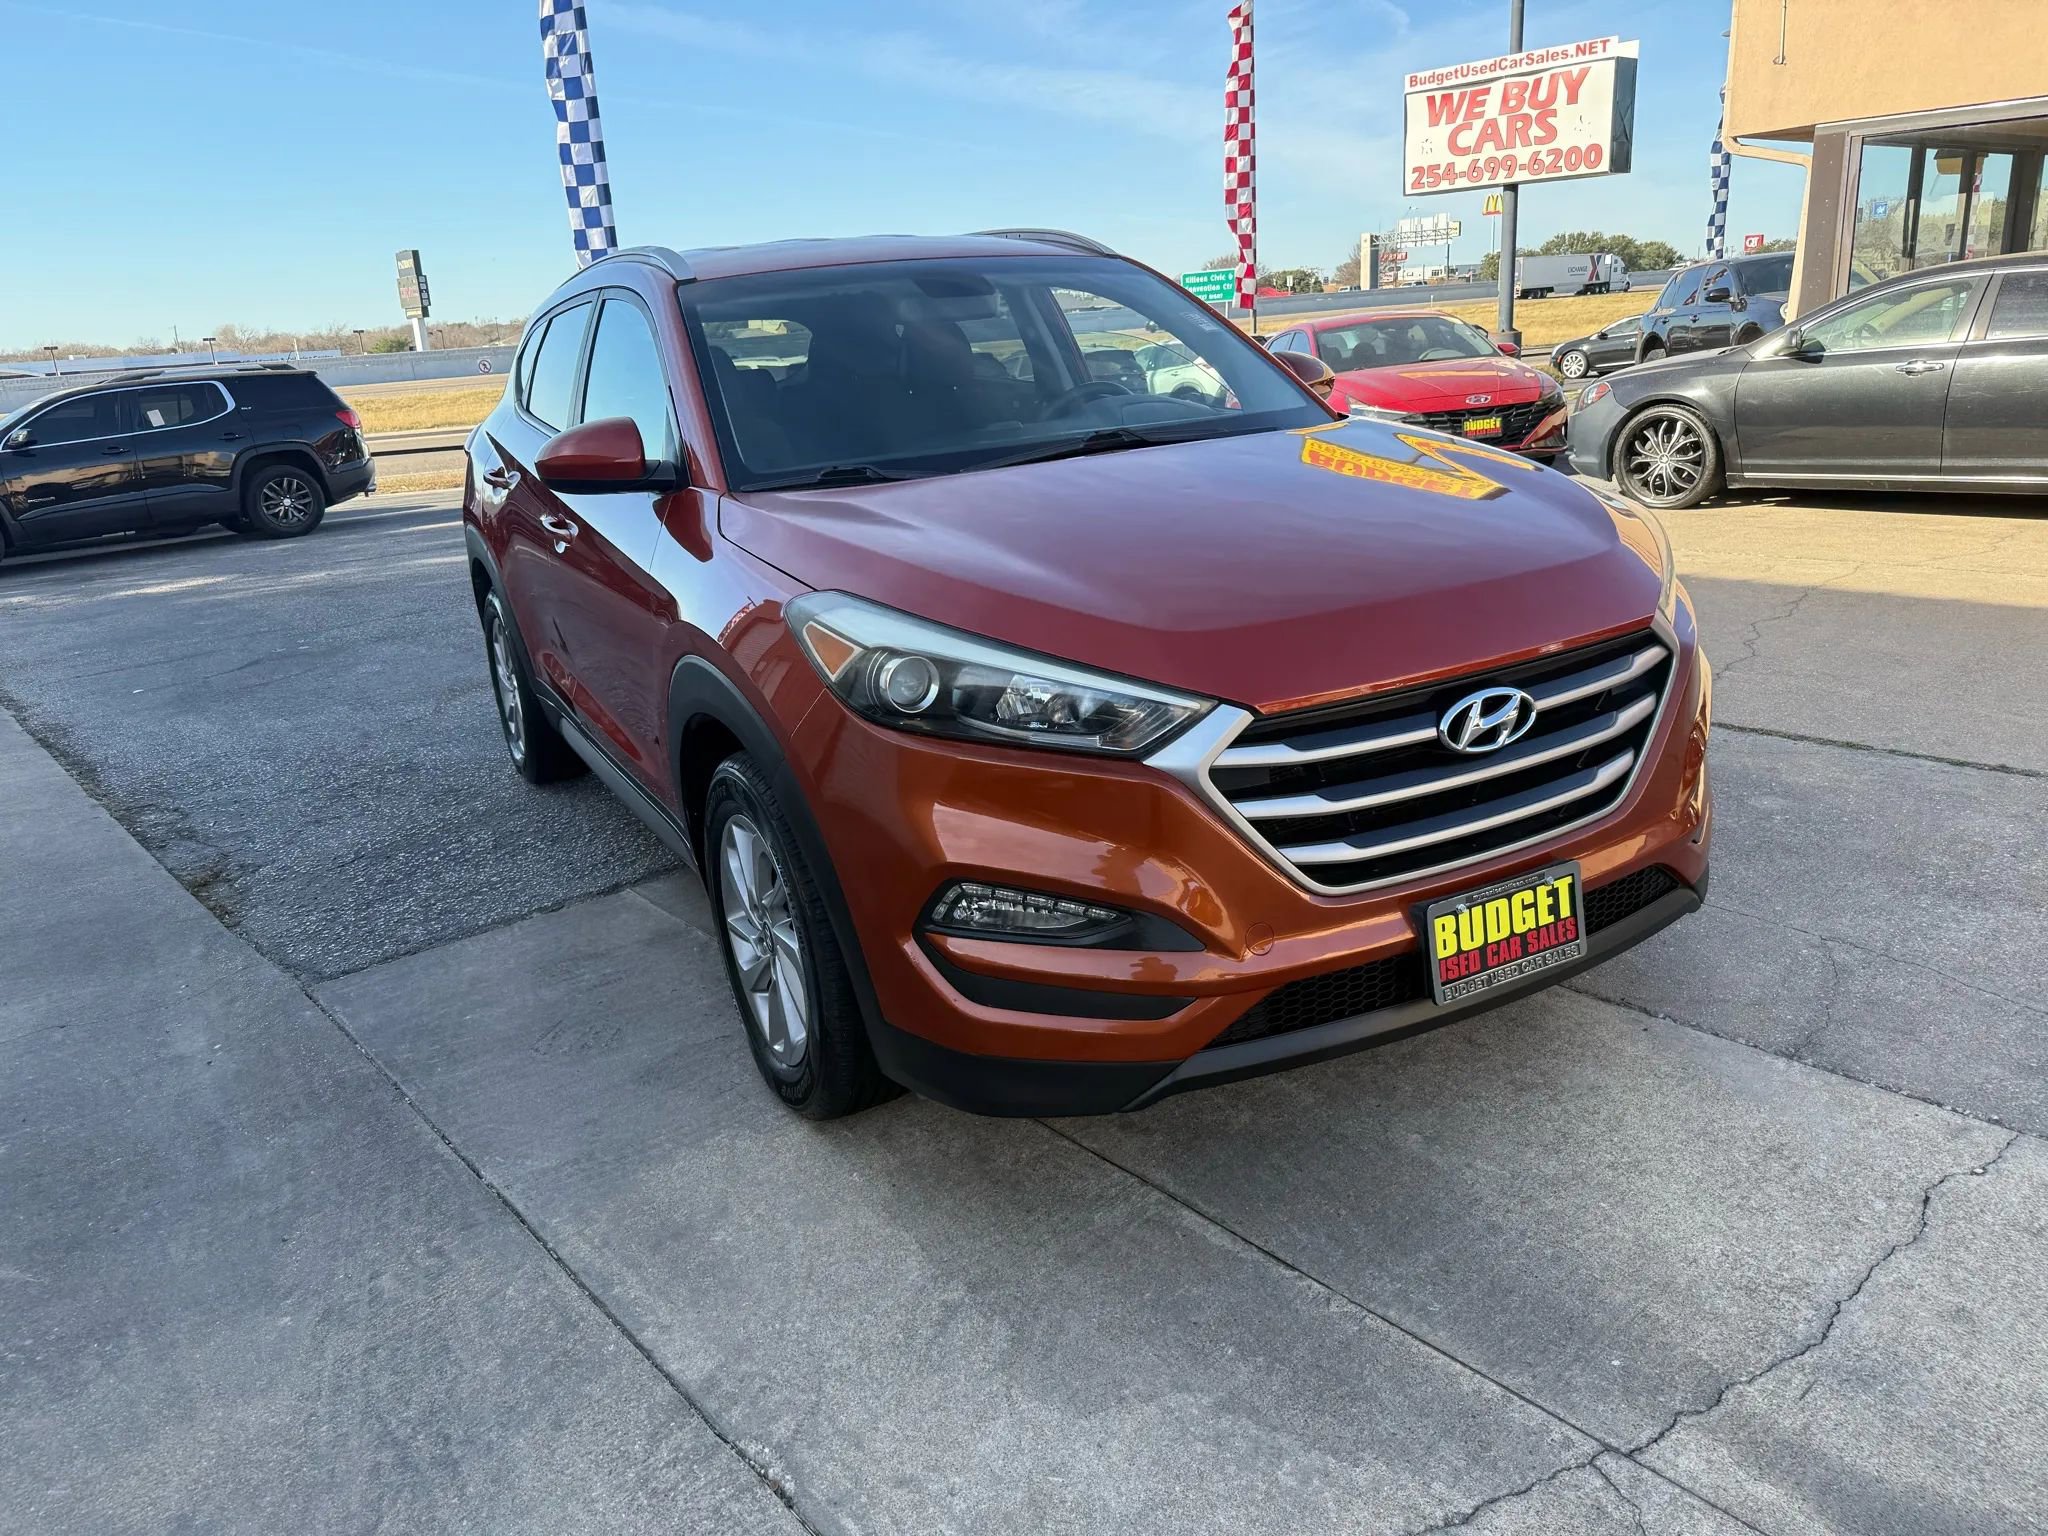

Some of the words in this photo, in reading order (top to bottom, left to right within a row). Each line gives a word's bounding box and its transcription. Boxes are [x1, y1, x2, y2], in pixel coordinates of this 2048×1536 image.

[1409, 39, 1610, 88] BudgetUsedCarSales.NET
[1426, 87, 1491, 127] WE
[1498, 66, 1592, 116] BUY
[1447, 109, 1558, 156] CARS
[1411, 143, 1603, 190] 254-699-6200
[1185, 275, 1208, 283] Killeen
[1210, 273, 1226, 281] Civic
[1464, 418, 1502, 431] BUDGET
[1433, 875, 1573, 960] BUDGET
[1486, 936, 1522, 967] CAR
[1527, 917, 1577, 953] SALES
[1444, 976, 1490, 1001] BUDGET
[1491, 966, 1519, 983] USED
[1521, 958, 1545, 973] CAR
[1545, 945, 1579, 965] SALES
